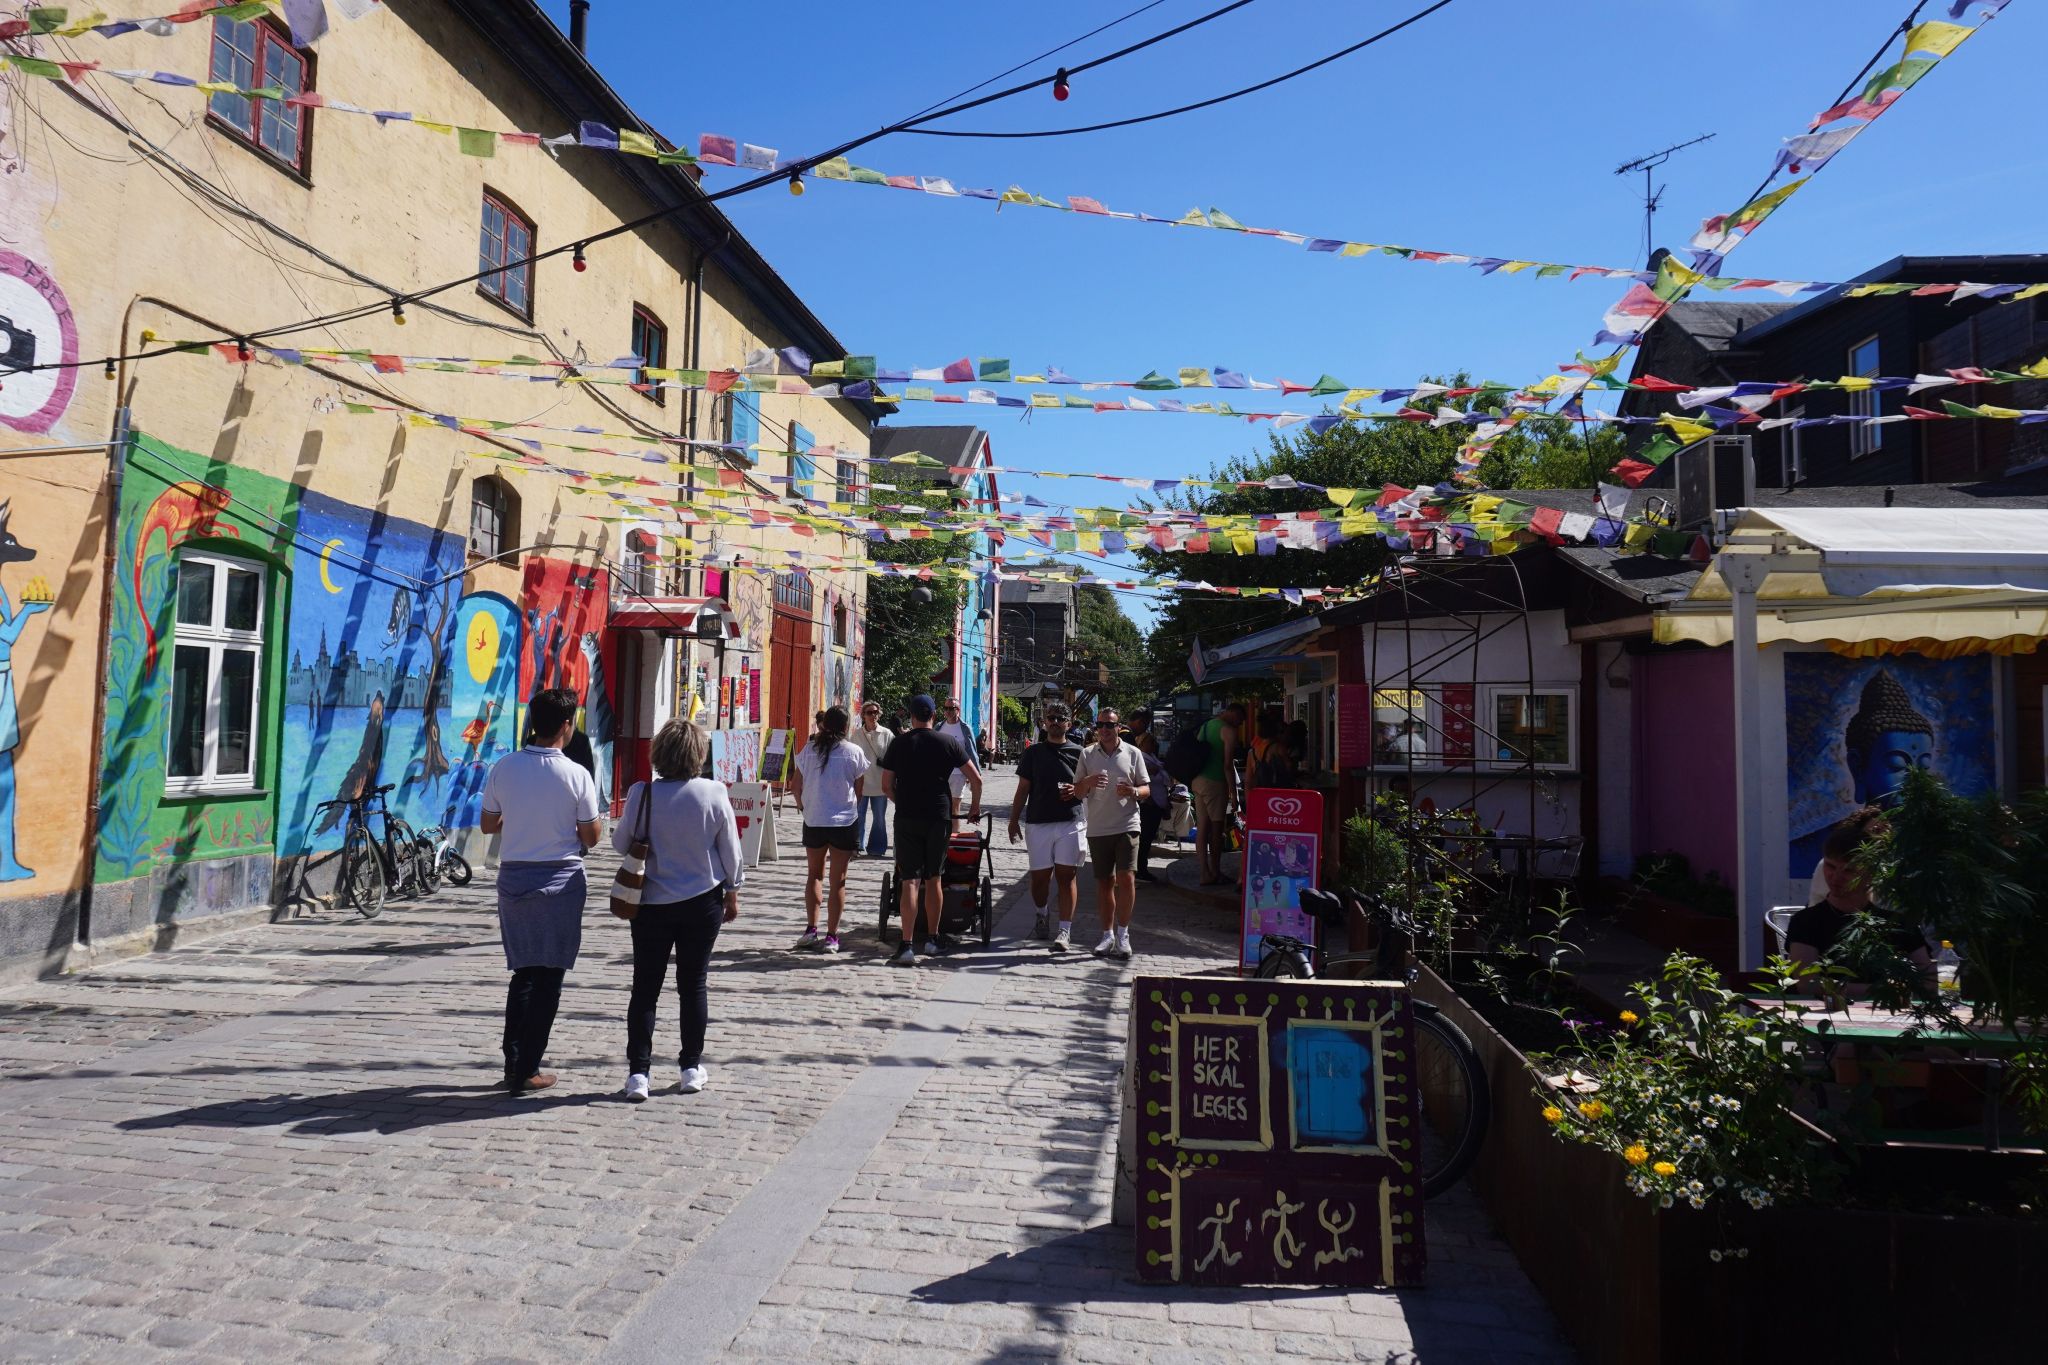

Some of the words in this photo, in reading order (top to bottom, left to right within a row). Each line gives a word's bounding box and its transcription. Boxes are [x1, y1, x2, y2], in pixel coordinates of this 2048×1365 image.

[23, 259, 74, 329] FREE
[1374, 689, 1422, 707] Sunshne
[1268, 816, 1300, 826] FRISKO
[1193, 1034, 1241, 1063] HER
[1193, 1062, 1245, 1089] SKAL
[1193, 1092, 1248, 1121] LEGES
